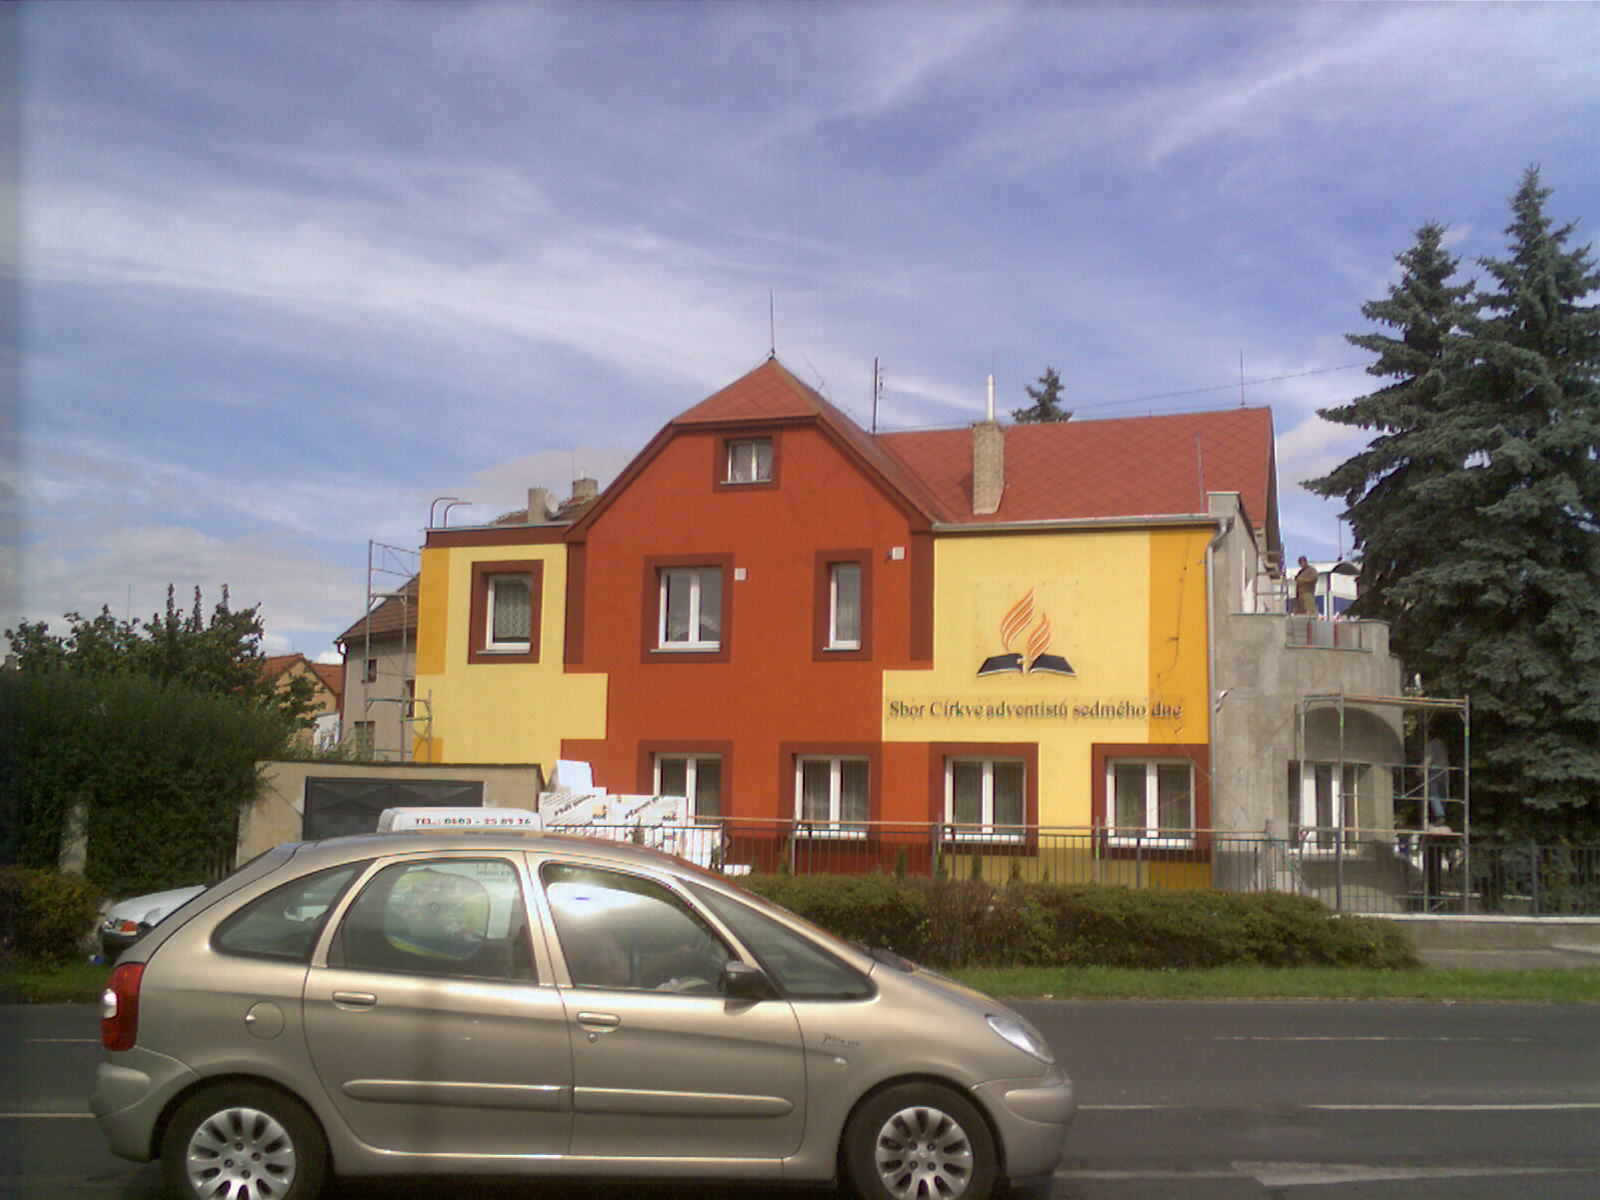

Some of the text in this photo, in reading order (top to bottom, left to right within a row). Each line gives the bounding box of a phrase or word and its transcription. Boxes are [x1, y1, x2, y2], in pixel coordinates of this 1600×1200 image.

[890, 701, 924, 717] Sbor
[1073, 701, 1146, 717] sedmého
[1151, 701, 1182, 717] dne
